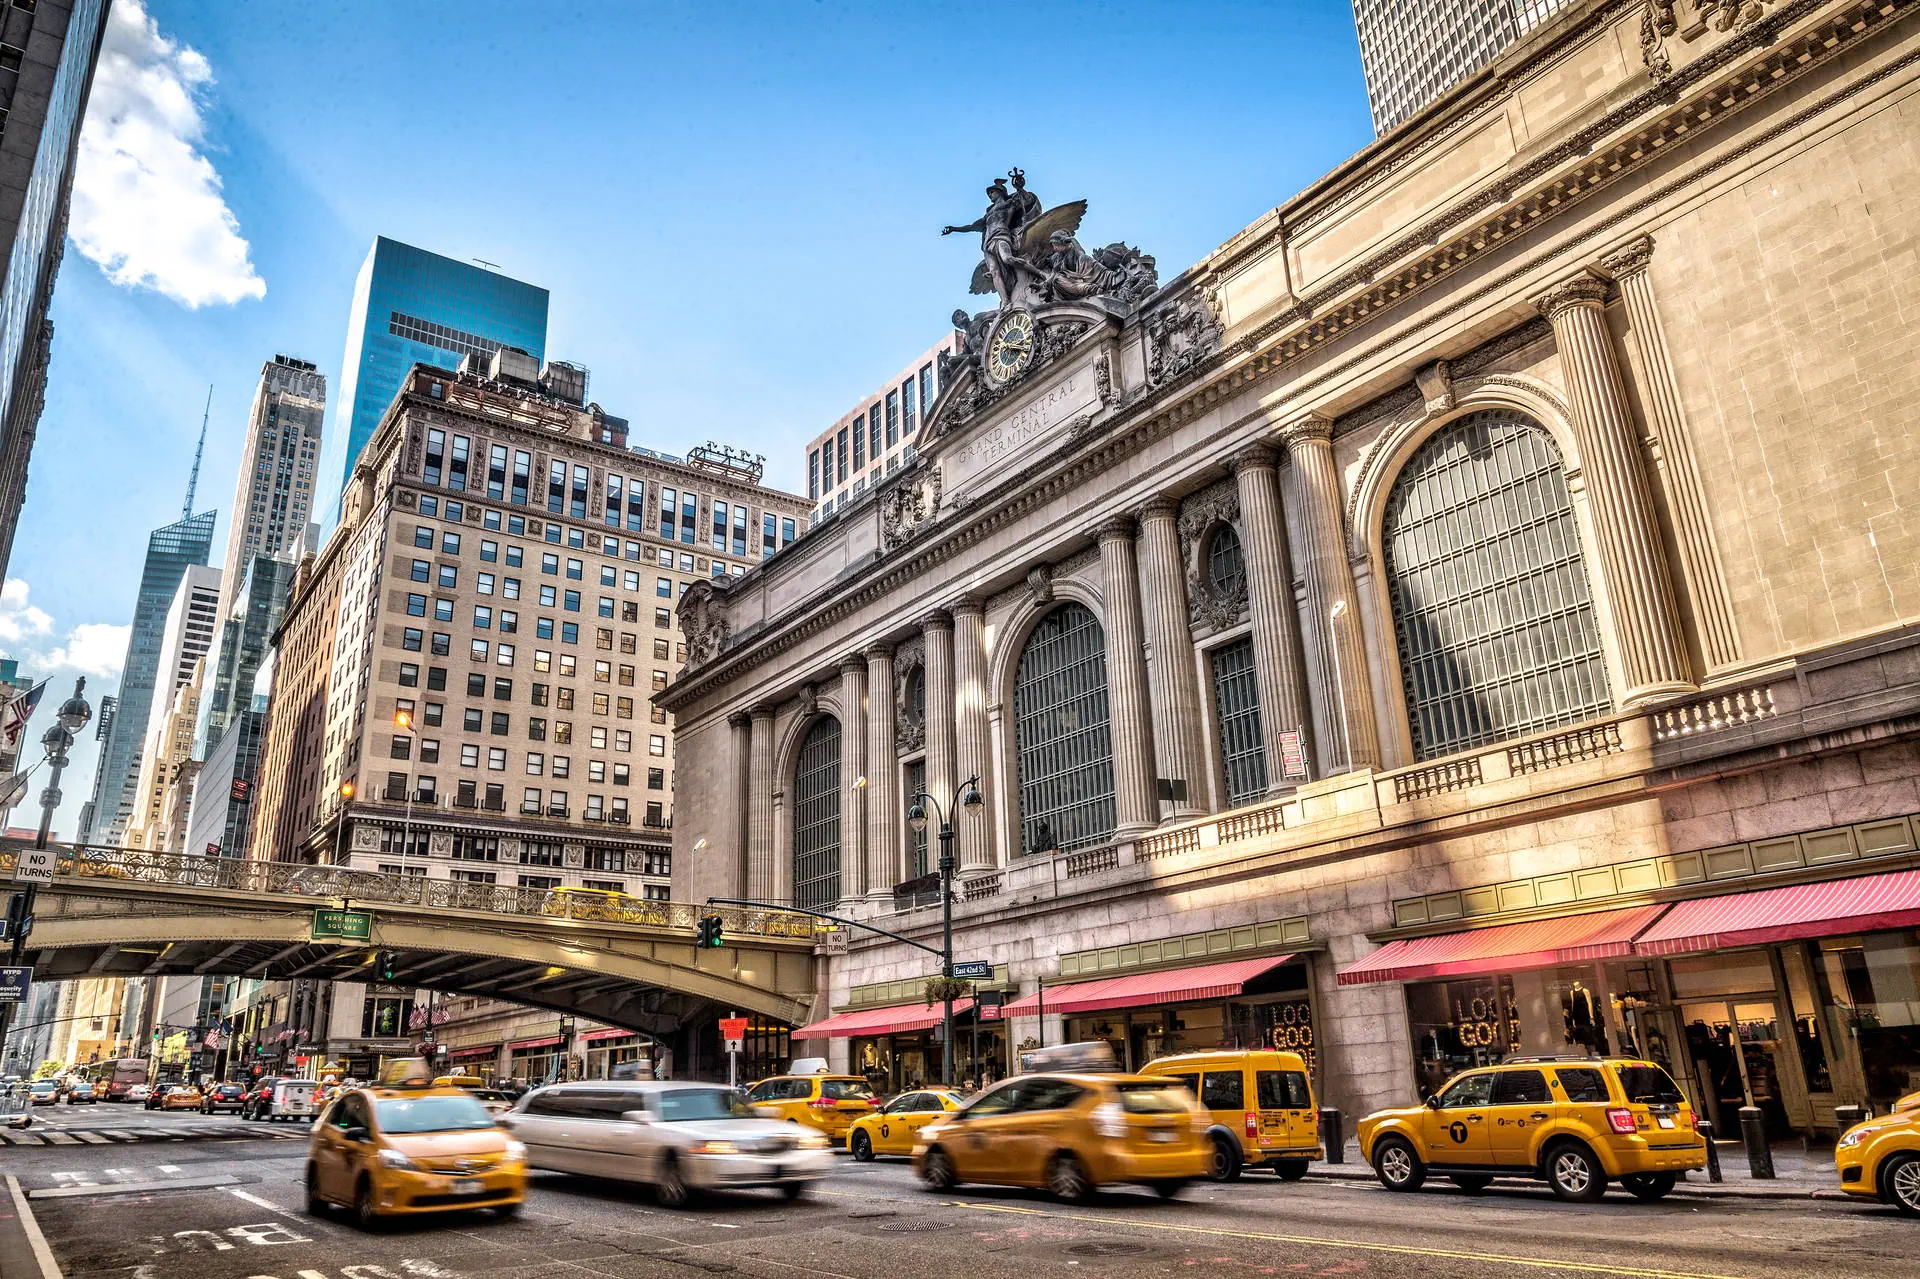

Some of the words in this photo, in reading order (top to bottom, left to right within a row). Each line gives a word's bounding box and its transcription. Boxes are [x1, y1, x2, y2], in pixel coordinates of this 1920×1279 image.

[959, 428, 1002, 464] GRAND
[1011, 380, 1076, 429] CENTRAL
[983, 413, 1050, 463] TERMINAL
[29, 854, 46, 865] NO
[19, 867, 52, 878] TURNS
[324, 915, 363, 924] PERSHING
[328, 923, 357, 931] SQUARE
[832, 935, 842, 943] NO
[828, 944, 847, 952] TURNS
[955, 966, 966, 975] East
[966, 965, 978, 974] 42nd
[978, 964, 985, 973] St
[0, 985, 23, 993] ecurity
[1271, 1003, 1311, 1026] LOO
[1272, 1025, 1313, 1048] GOO
